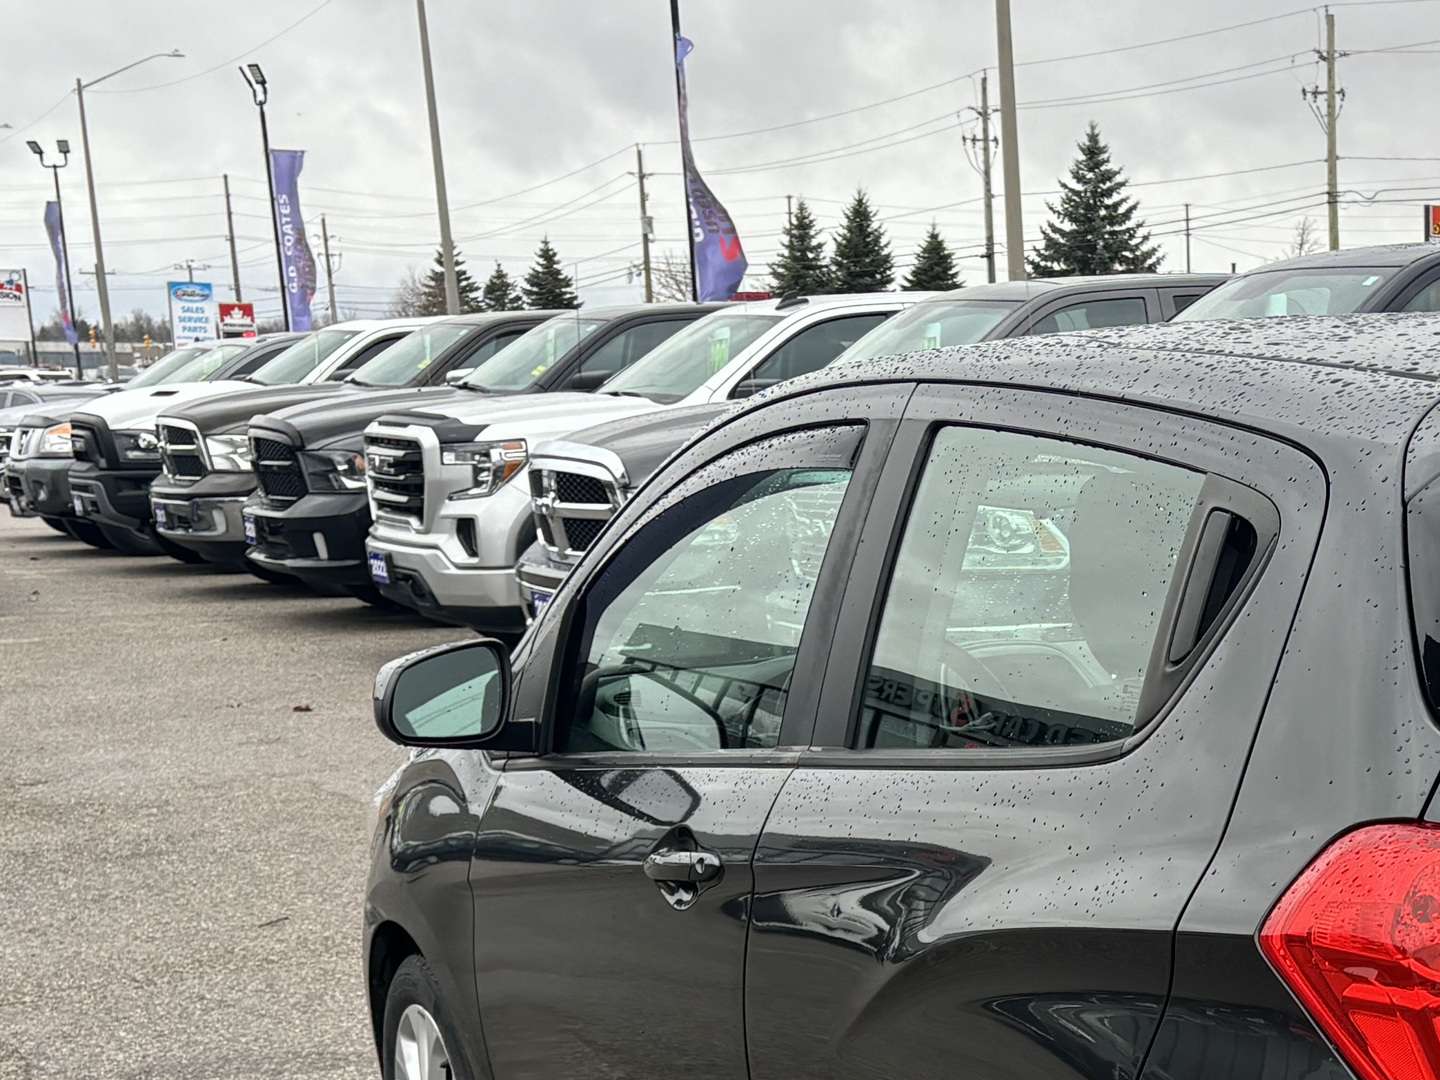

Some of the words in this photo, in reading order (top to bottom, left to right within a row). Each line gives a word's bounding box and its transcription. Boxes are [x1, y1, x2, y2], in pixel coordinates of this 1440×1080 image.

[277, 194, 295, 256] COATES
[181, 305, 205, 313] SALES
[178, 316, 208, 324] SERVICE
[182, 326, 208, 334] PARTS
